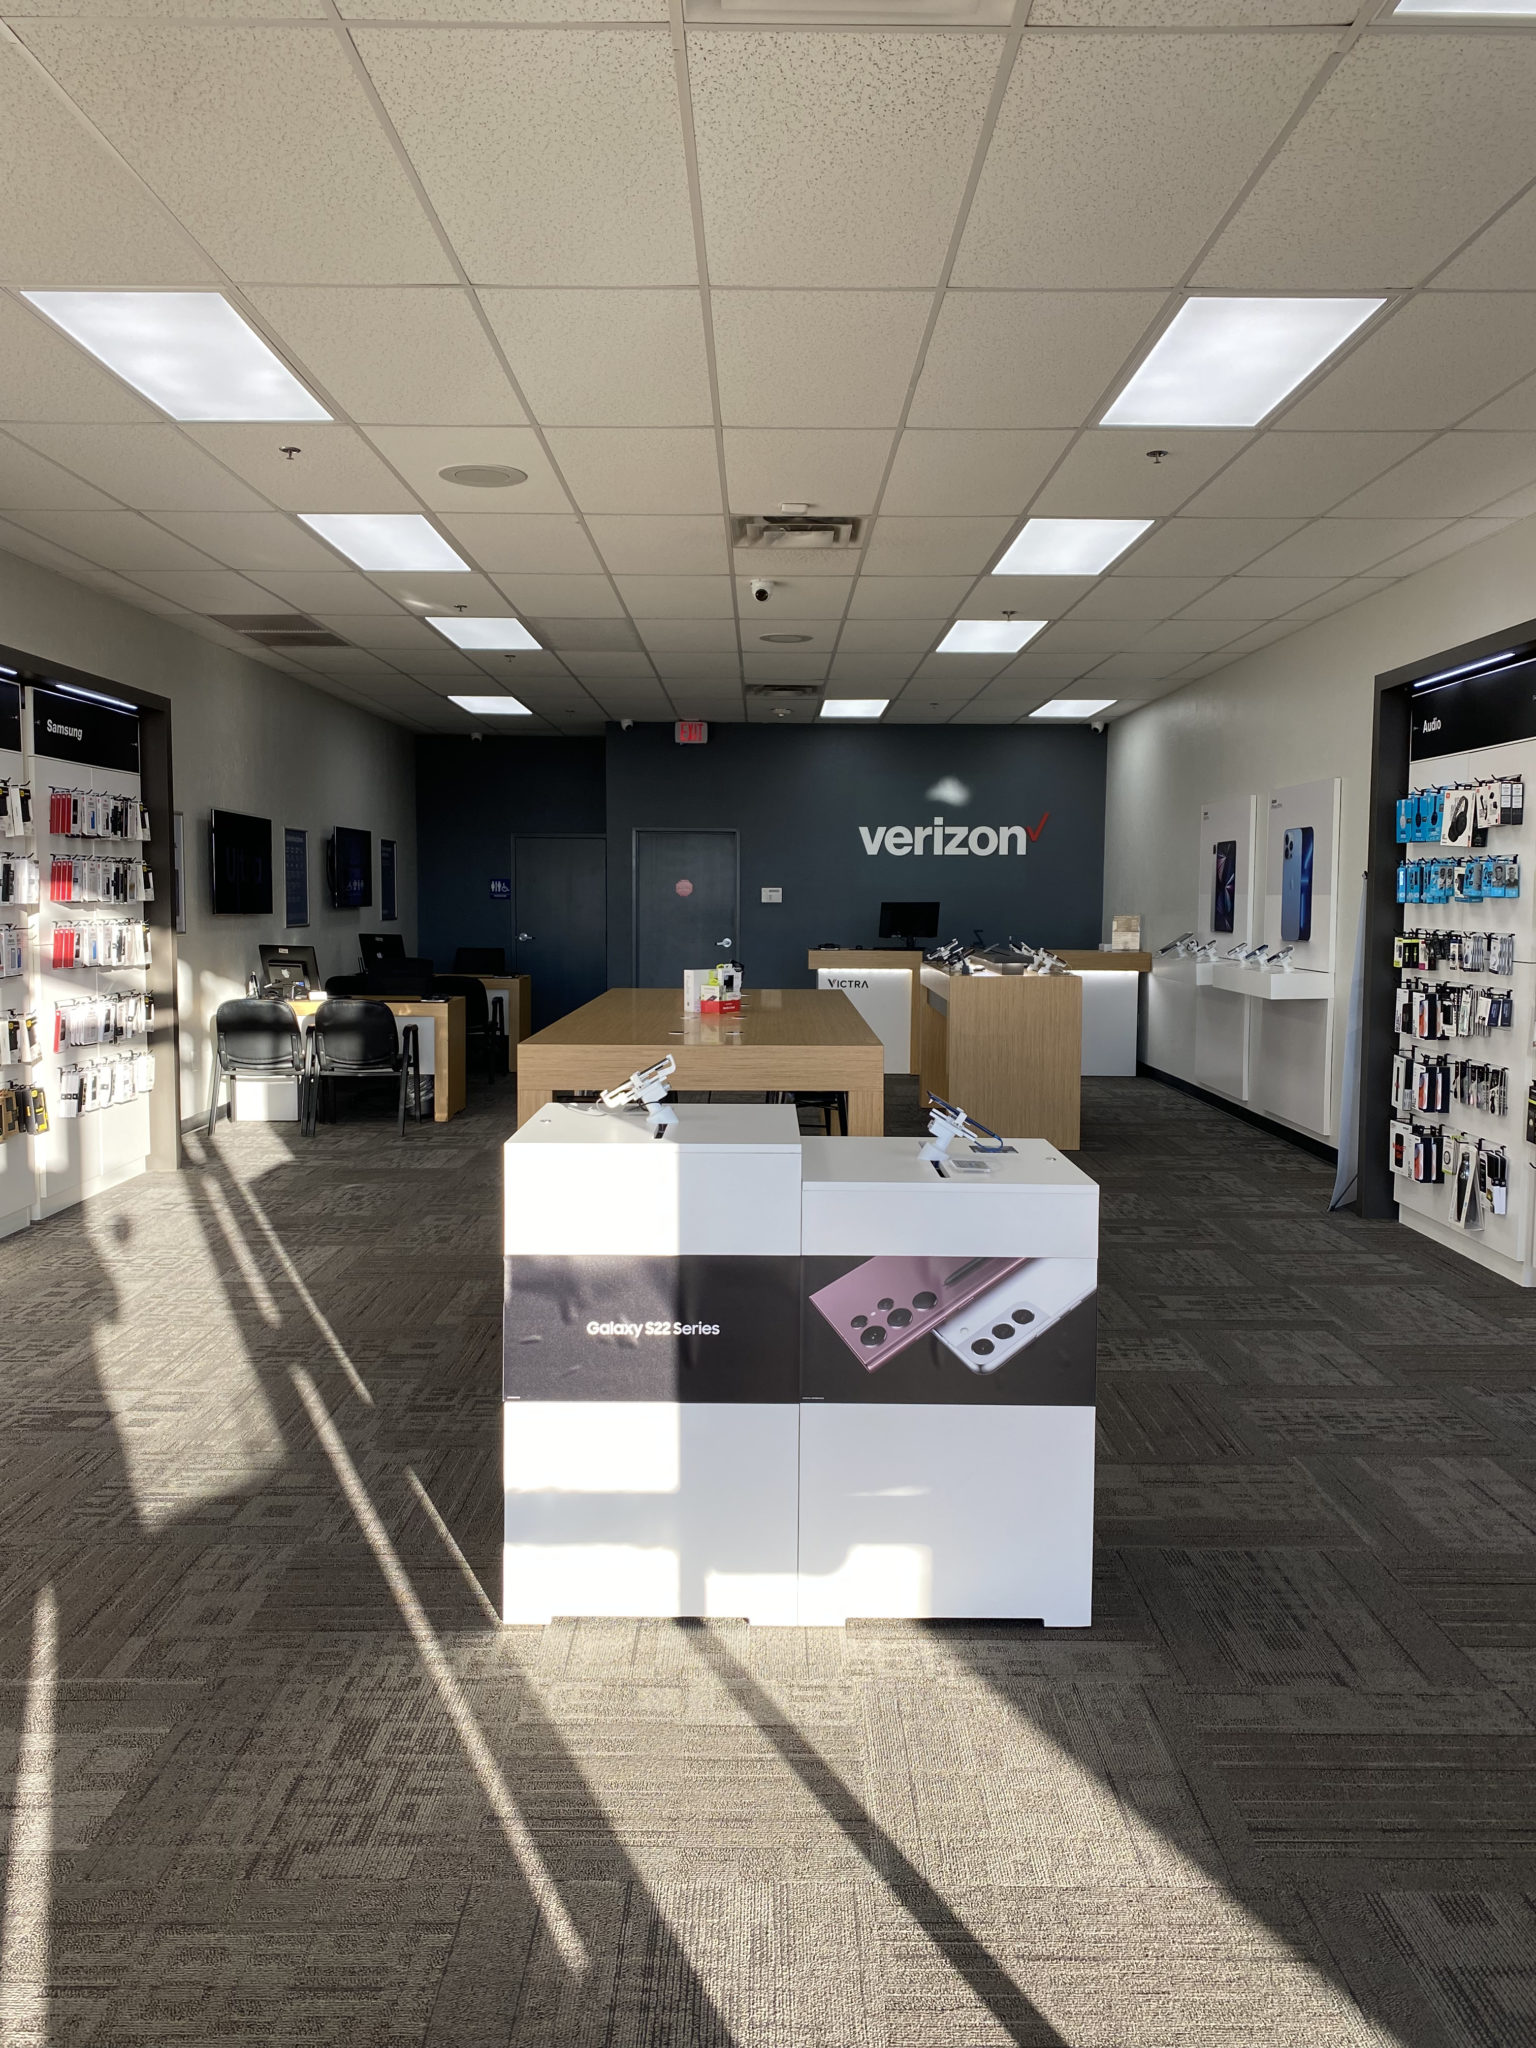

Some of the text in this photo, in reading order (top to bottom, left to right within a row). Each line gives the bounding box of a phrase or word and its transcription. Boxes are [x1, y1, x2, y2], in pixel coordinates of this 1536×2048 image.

[46, 718, 83, 741] Samsung
[680, 722, 705, 742] EXIT
[1422, 716, 1442, 734] Audio
[859, 816, 1027, 857] verizon
[827, 978, 869, 989] VICTRA
[586, 1320, 721, 1339] Galaxy S22 Series
